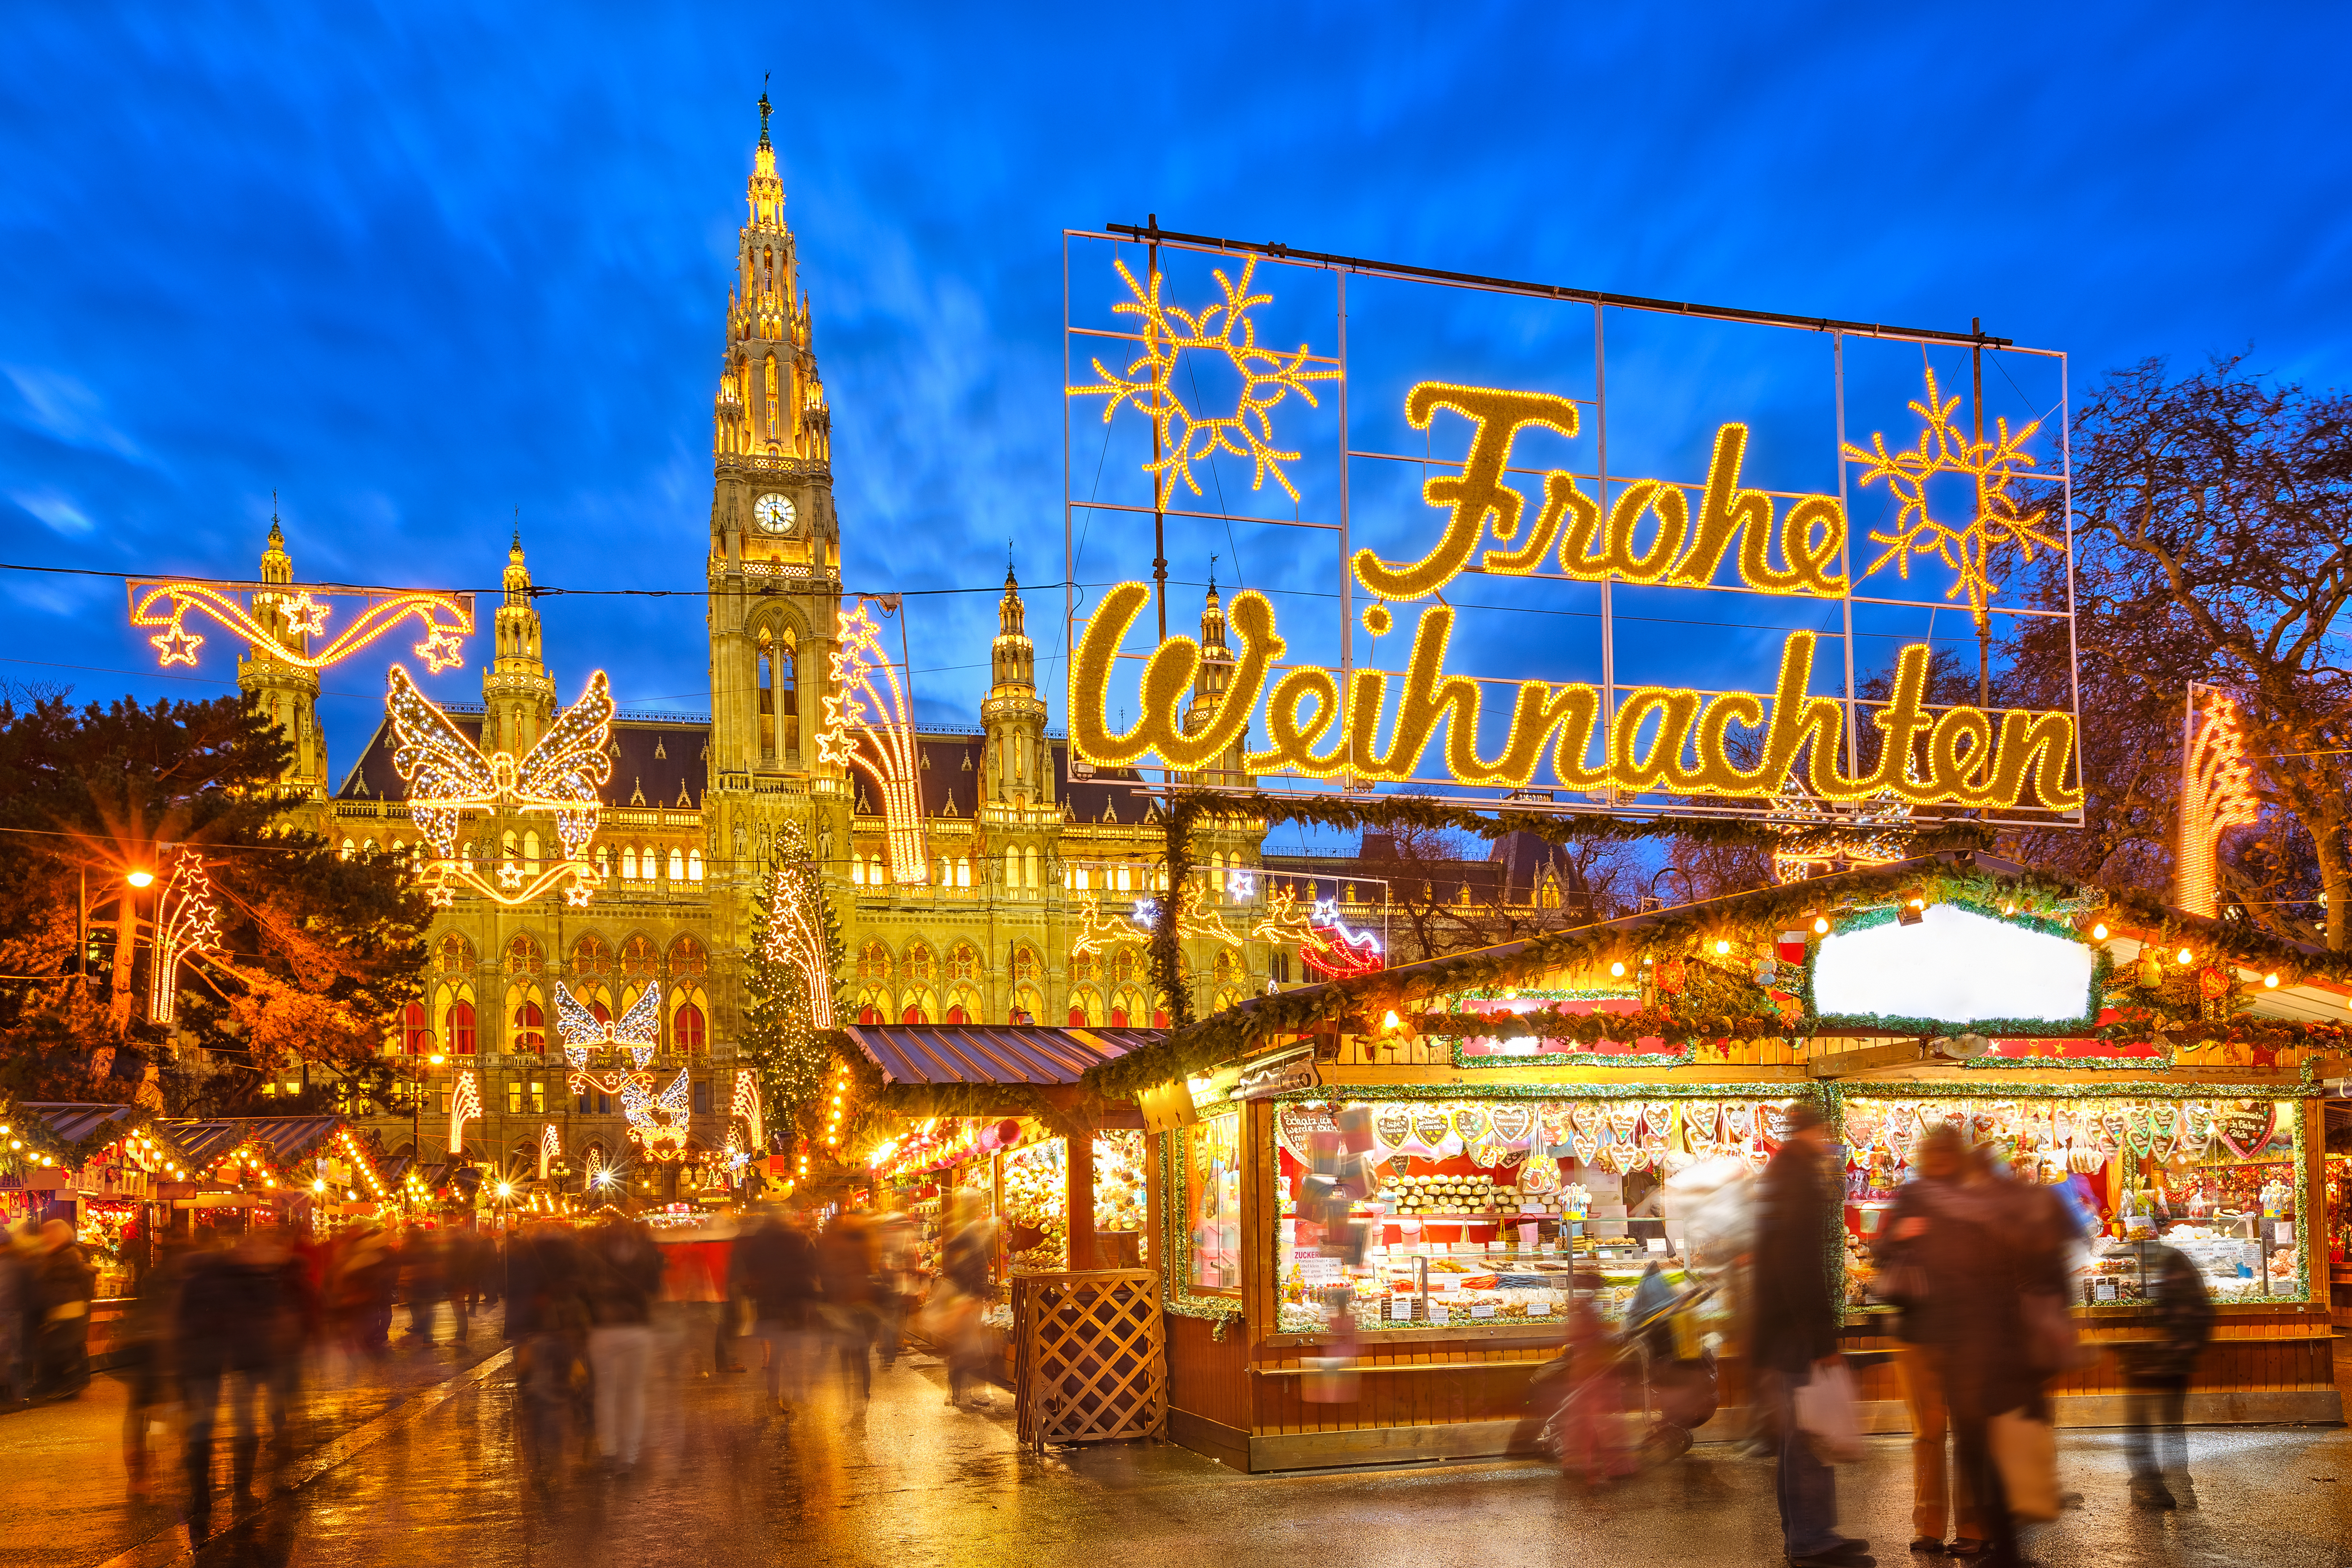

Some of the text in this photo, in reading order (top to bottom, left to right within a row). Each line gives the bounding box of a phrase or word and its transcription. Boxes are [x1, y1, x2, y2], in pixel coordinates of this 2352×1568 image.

[1352, 380, 1848, 602] Frohe
[1068, 580, 2084, 811] Weihnachten
[1319, 1115, 1332, 1125] ich
[1768, 1113, 1789, 1124] Ich
[1847, 1113, 1872, 1123] Ich liebe
[2231, 1110, 2267, 1122] inzessin,
[1286, 1125, 1314, 1134] werde
[1772, 1123, 1794, 1132] liebe
[2229, 1120, 2237, 1129] ch
[2239, 1119, 2256, 1131] liebe
[1465, 1129, 1475, 1137] you
[2228, 1129, 2248, 1139] Dich
[1294, 1251, 1321, 1259] ZUCKER
